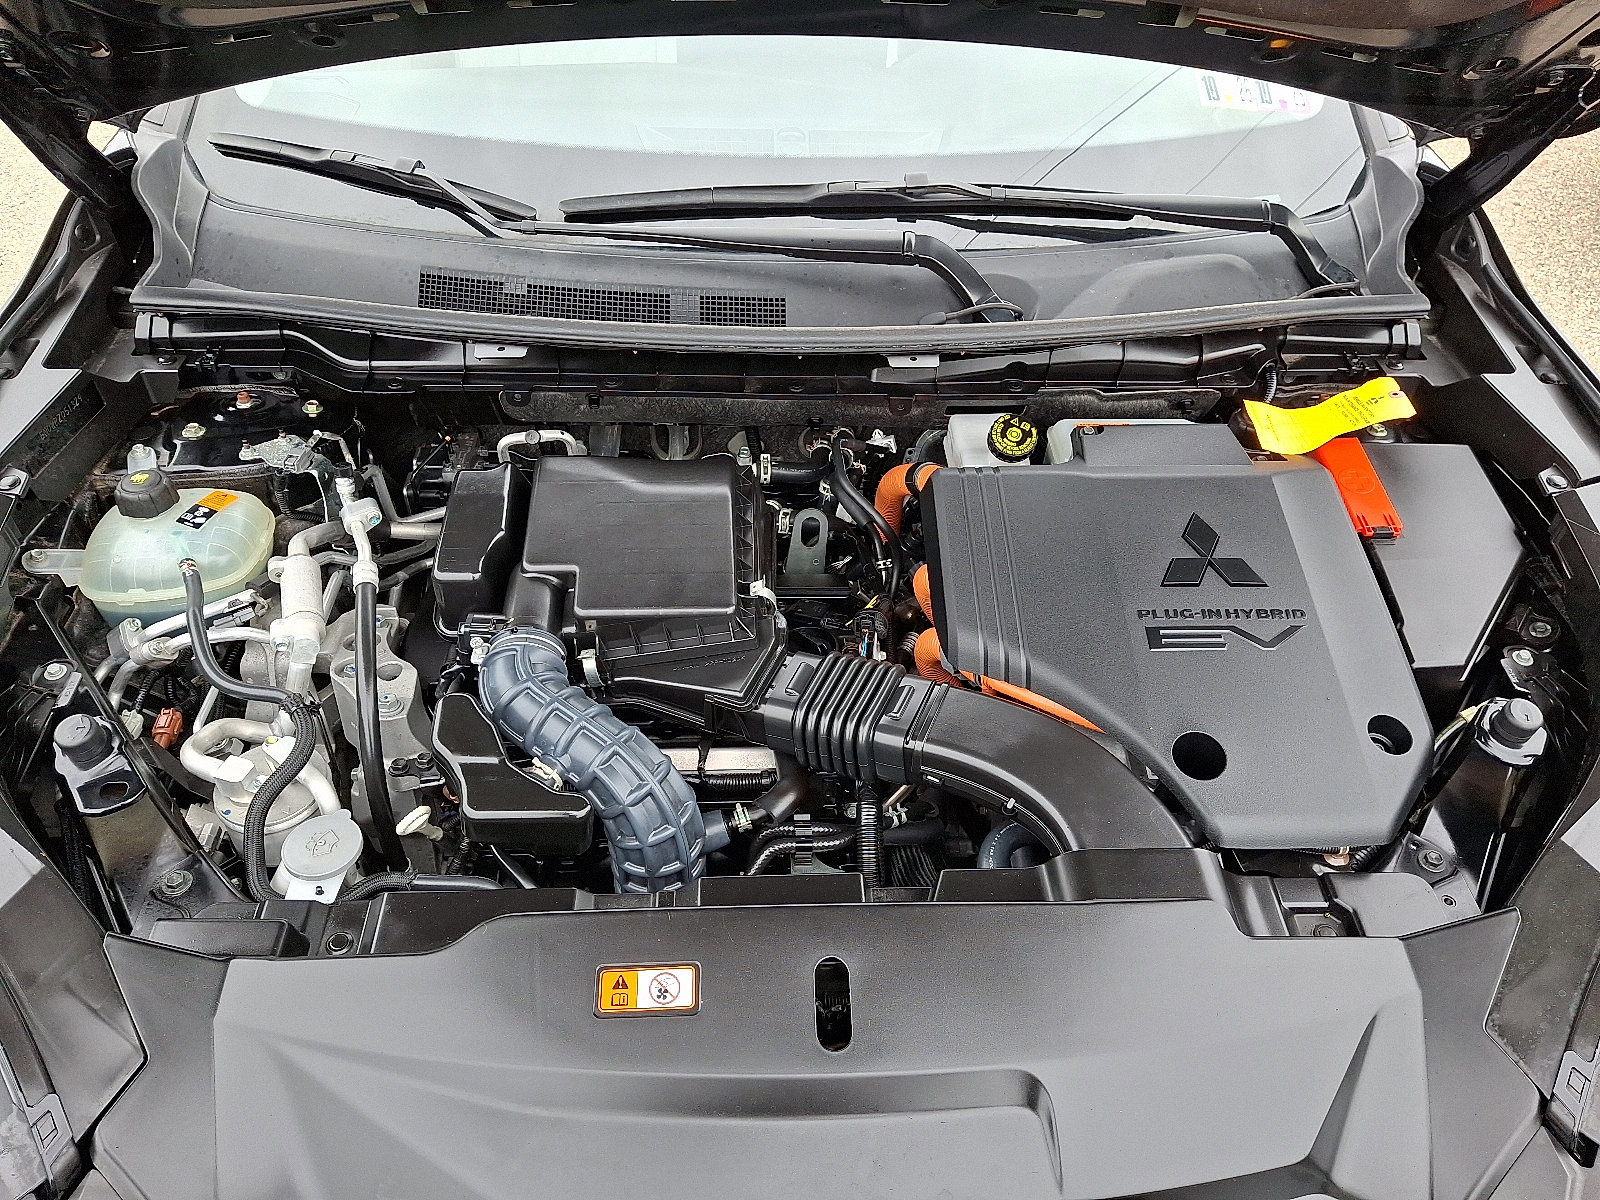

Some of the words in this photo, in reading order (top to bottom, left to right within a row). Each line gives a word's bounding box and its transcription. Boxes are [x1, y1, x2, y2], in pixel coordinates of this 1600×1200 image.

[1136, 608, 1223, 621] PLUG-IN
[1225, 608, 1307, 621] HYBRID
[1145, 625, 1307, 651] EV
